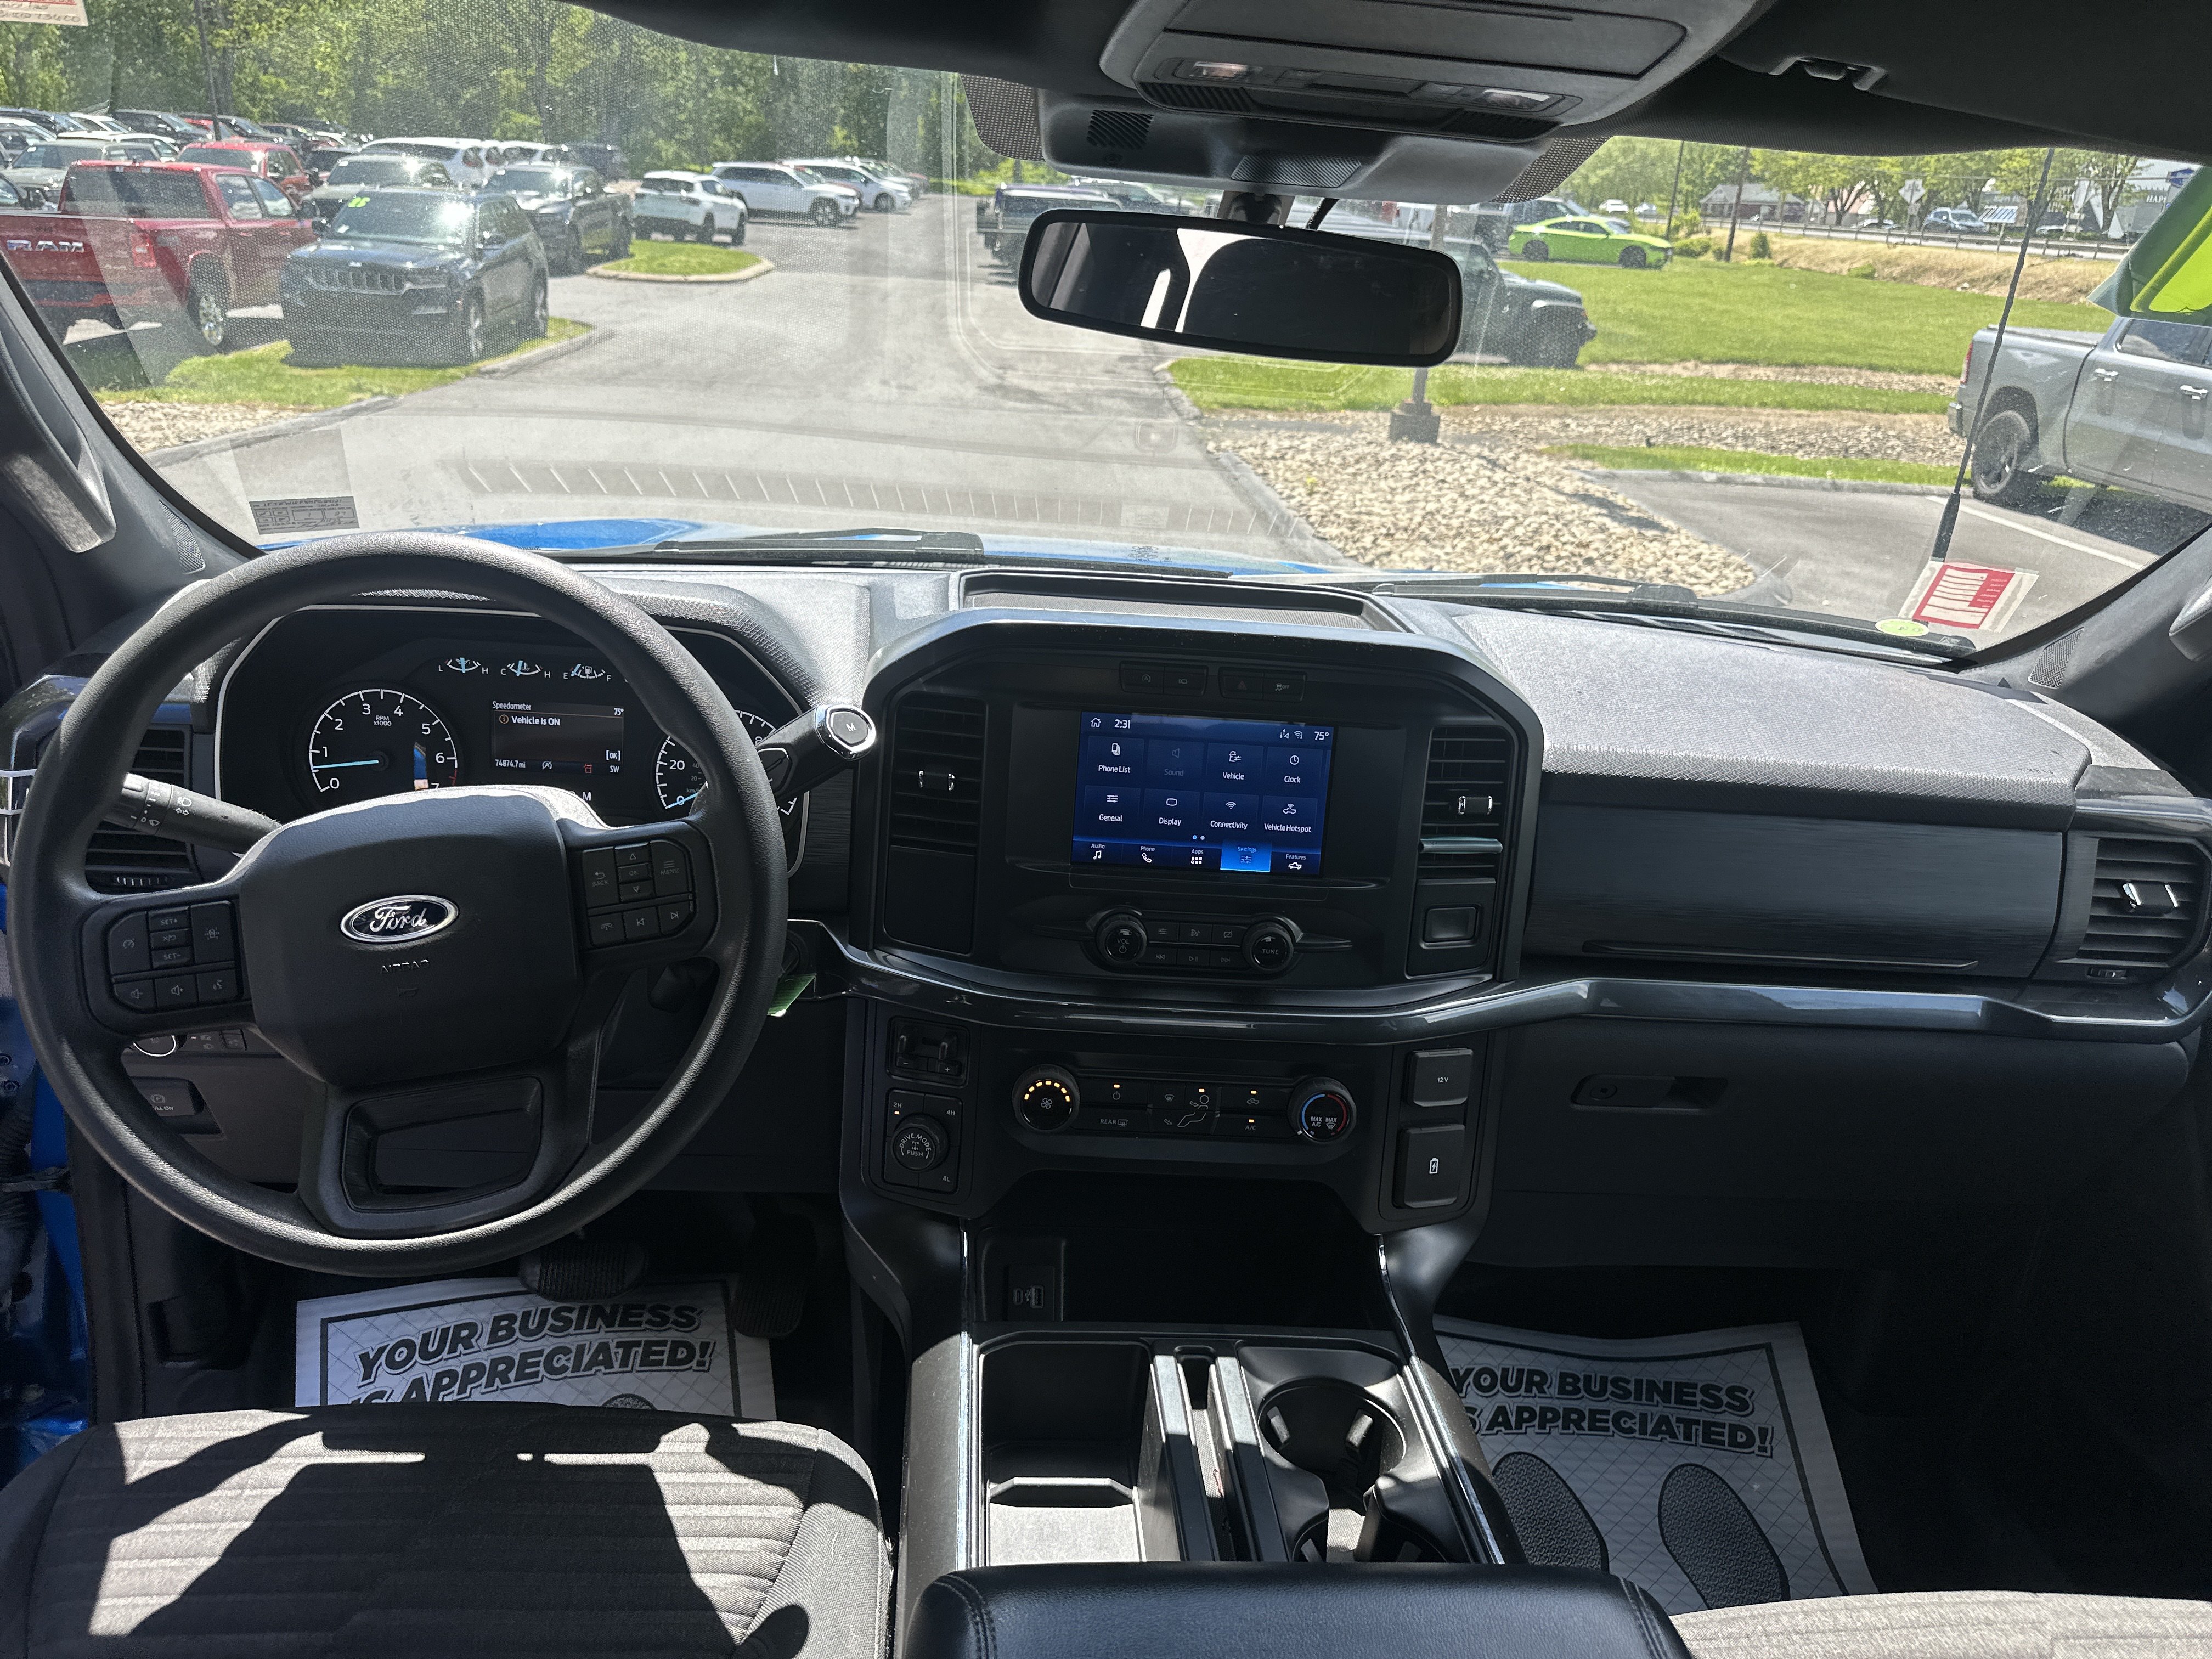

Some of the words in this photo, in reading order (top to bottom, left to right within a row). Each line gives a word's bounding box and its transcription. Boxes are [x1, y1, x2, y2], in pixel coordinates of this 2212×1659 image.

[2146, 195, 2166, 203] HAP
[7, 239, 84, 253] RAM
[362, 703, 371, 714] 3
[393, 706, 403, 716] 4
[492, 701, 532, 711] Speedometer
[614, 708, 624, 716] 75°
[335, 719, 343, 730] 2
[511, 715, 539, 725] Vehicle
[548, 718, 560, 726] ON
[1114, 719, 1131, 729] 2:31
[422, 723, 431, 735] 5
[845, 723, 856, 732] M
[755, 736, 763, 744] 8
[1314, 731, 1330, 741] 75°
[322, 746, 328, 757] 1
[436, 752, 445, 763] 6
[495, 759, 518, 768] 74874.7
[669, 760, 685, 770] 20
[1098, 764, 1118, 774] Phone
[1119, 765, 1131, 774] List
[1164, 769, 1184, 777] Sound
[1222, 772, 1244, 781] Vehicle
[1284, 775, 1301, 784] Clock
[330, 777, 340, 789] 0
[582, 791, 591, 801] M
[676, 795, 685, 805] 0
[1099, 814, 1123, 823] General
[1159, 817, 1181, 827] Display
[1210, 821, 1248, 831] Connectivity
[1264, 823, 1285, 832] Vehicle
[1286, 824, 1312, 834] Hotspot
[369, 905, 427, 932] Ford
[899, 1133, 915, 1149] DRIVE
[916, 1133, 932, 1152] MODE
[358, 1322, 481, 1384] YOUR
[487, 1304, 702, 1346] BUSINESS
[398, 1340, 714, 1403] APPRECIATED!
[1451, 1367, 1549, 1396] YOUR
[1558, 1371, 1753, 1413] BUSINESS
[1486, 1404, 1773, 1455] APPRECIATED!
